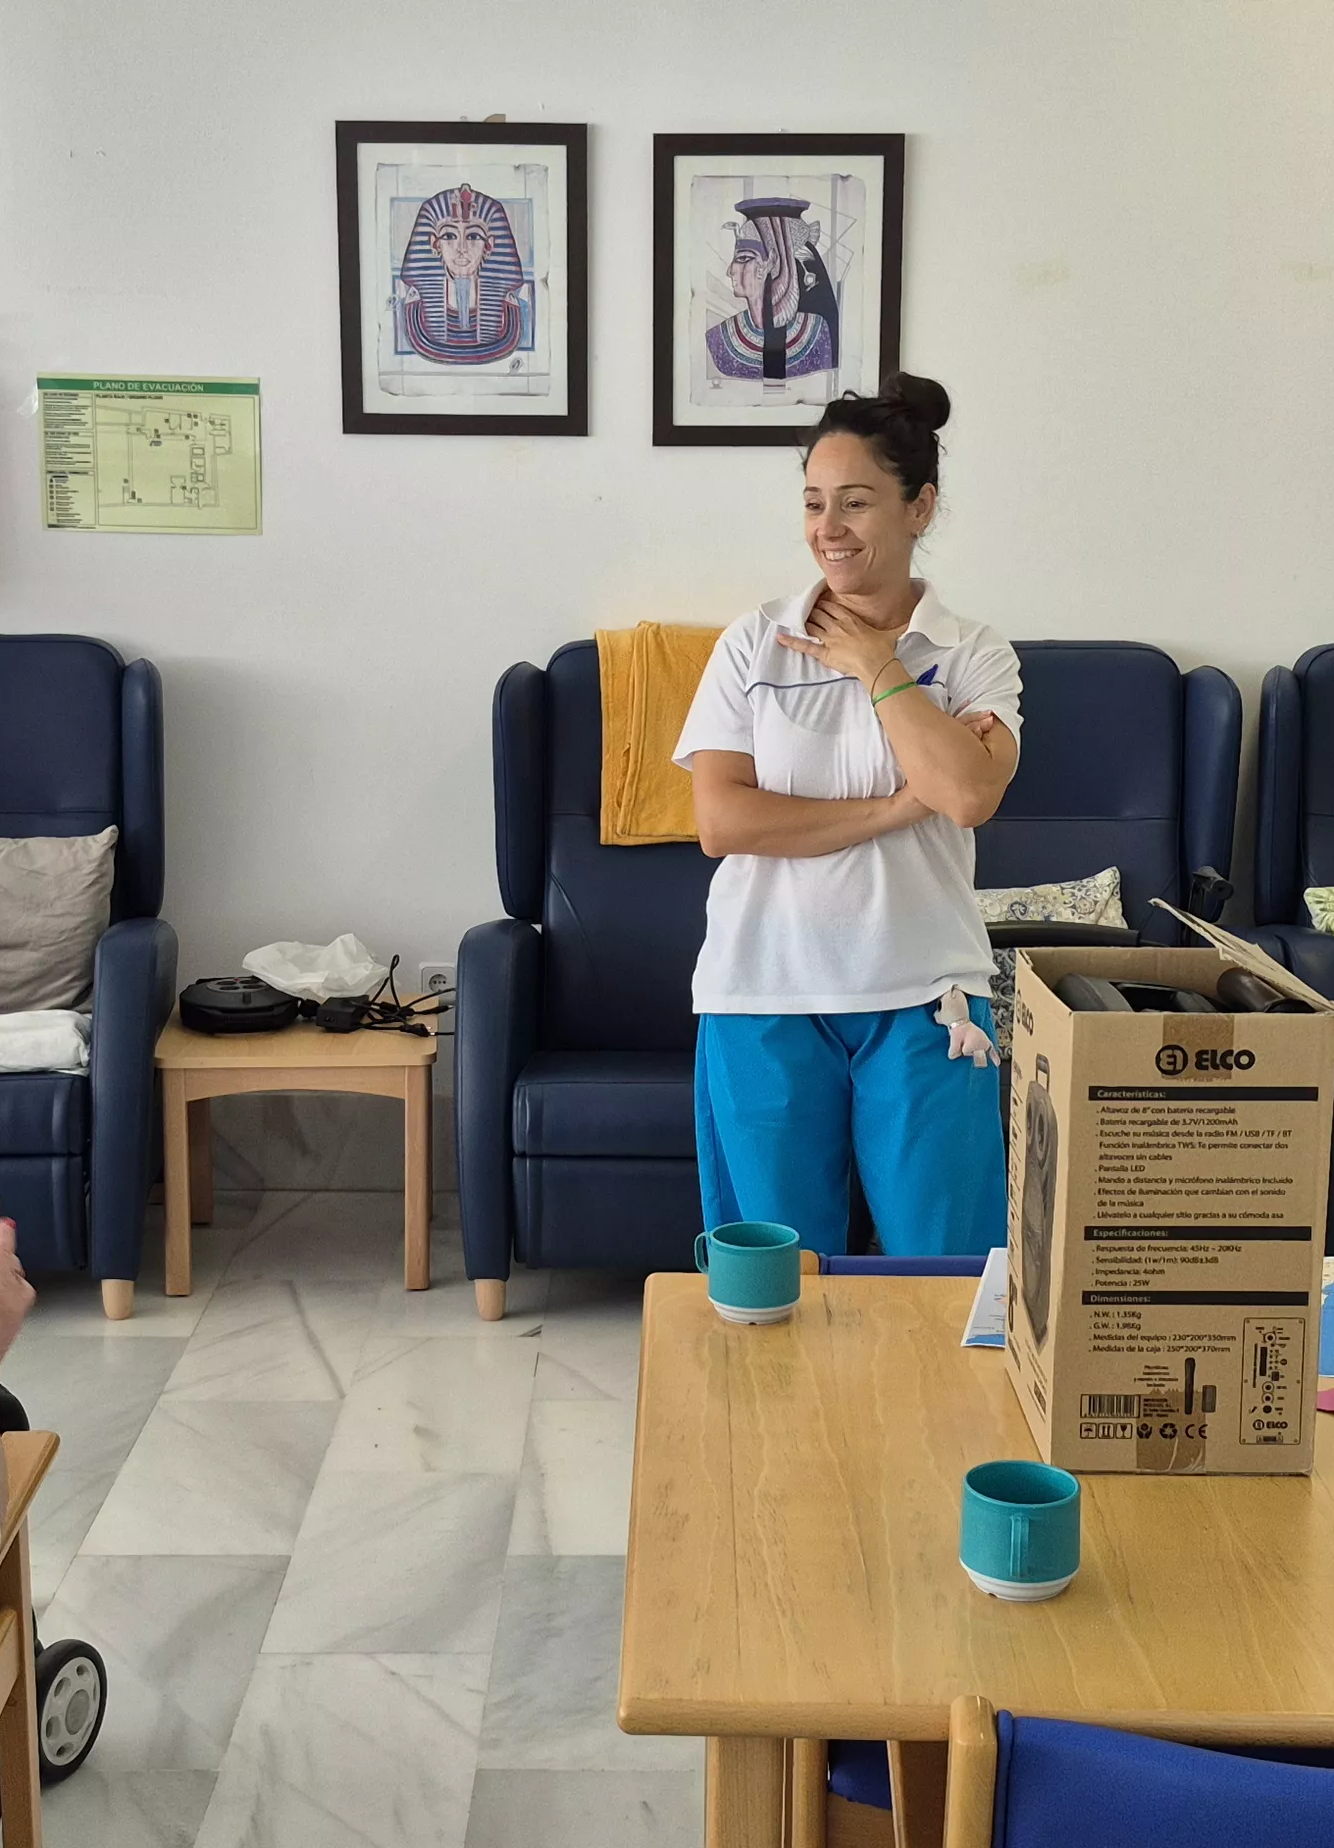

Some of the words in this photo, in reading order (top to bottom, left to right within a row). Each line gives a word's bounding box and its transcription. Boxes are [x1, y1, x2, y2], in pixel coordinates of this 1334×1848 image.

[93, 381, 125, 390] PLANO
[128, 382, 141, 391] DE
[143, 382, 204, 392] EVACUACIÓN
[1195, 1049, 1256, 1071] ELCO
[1097, 1089, 1167, 1099] Características:
[1100, 1106, 1128, 1114] Altavoz
[1130, 1106, 1140, 1114] de
[1151, 1106, 1165, 1114] con
[1167, 1106, 1194, 1114] batería
[1195, 1107, 1236, 1115] recargable
[1128, 1119, 1168, 1127] recargable
[1099, 1130, 1131, 1138] Escuche
[1132, 1130, 1142, 1138] su
[1142, 1130, 1169, 1138] música
[1171, 1130, 1195, 1138] desde
[1196, 1130, 1203, 1138] la
[1204, 1130, 1224, 1138] radio
[1226, 1130, 1238, 1138] FM
[1245, 1130, 1260, 1138] USB
[1267, 1130, 1276, 1138] TF
[1099, 1141, 1130, 1149] Función
[1198, 1141, 1206, 1149] Te
[1207, 1142, 1238, 1150] permite
[1239, 1141, 1273, 1149] conectar
[1274, 1141, 1288, 1149] dos
[1098, 1153, 1135, 1161] altavoces
[1136, 1153, 1147, 1161] sin
[1148, 1153, 1173, 1161] cables
[1098, 1164, 1129, 1172] Pantalla
[1130, 1164, 1146, 1172] LED
[1098, 1176, 1125, 1184] Mando
[1127, 1176, 1132, 1184] a
[1132, 1176, 1167, 1184] distancia
[1174, 1176, 1214, 1184] micrófono
[1097, 1188, 1125, 1196] Efectos
[1126, 1188, 1137, 1196] de
[1200, 1188, 1233, 1196] cambian
[1235, 1188, 1250, 1196] con
[1251, 1188, 1259, 1196] el
[1259, 1188, 1286, 1196] sonido
[1097, 1199, 1107, 1207] de
[1108, 1199, 1116, 1207] la
[1117, 1199, 1144, 1207] música
[1132, 1211, 1138, 1219] a
[1138, 1211, 1174, 1220] cualquier
[1175, 1211, 1192, 1219] sitio
[1193, 1212, 1220, 1220] gracias
[1221, 1211, 1227, 1219] a
[1228, 1211, 1238, 1219] su
[1270, 1211, 1284, 1219] asa
[1093, 1229, 1169, 1238] Especificaciones:
[1095, 1244, 1135, 1252] Respuesta
[1136, 1244, 1146, 1252] de
[1147, 1244, 1188, 1252] frecuencia:
[1095, 1256, 1142, 1265] Sensibilidad:
[1095, 1268, 1141, 1276] Impedancia:
[1142, 1268, 1166, 1276] 4ohm
[1094, 1279, 1128, 1287] Potencia
[1132, 1279, 1151, 1287] 25W
[1090, 1294, 1151, 1303] Dimensiones:
[1093, 1334, 1125, 1342] Medidas
[1126, 1334, 1139, 1342] del
[1140, 1335, 1167, 1343] equipo
[1092, 1345, 1124, 1353] Medidas
[1126, 1345, 1137, 1353] de
[1137, 1345, 1145, 1353] la
[1145, 1345, 1162, 1354] caja
